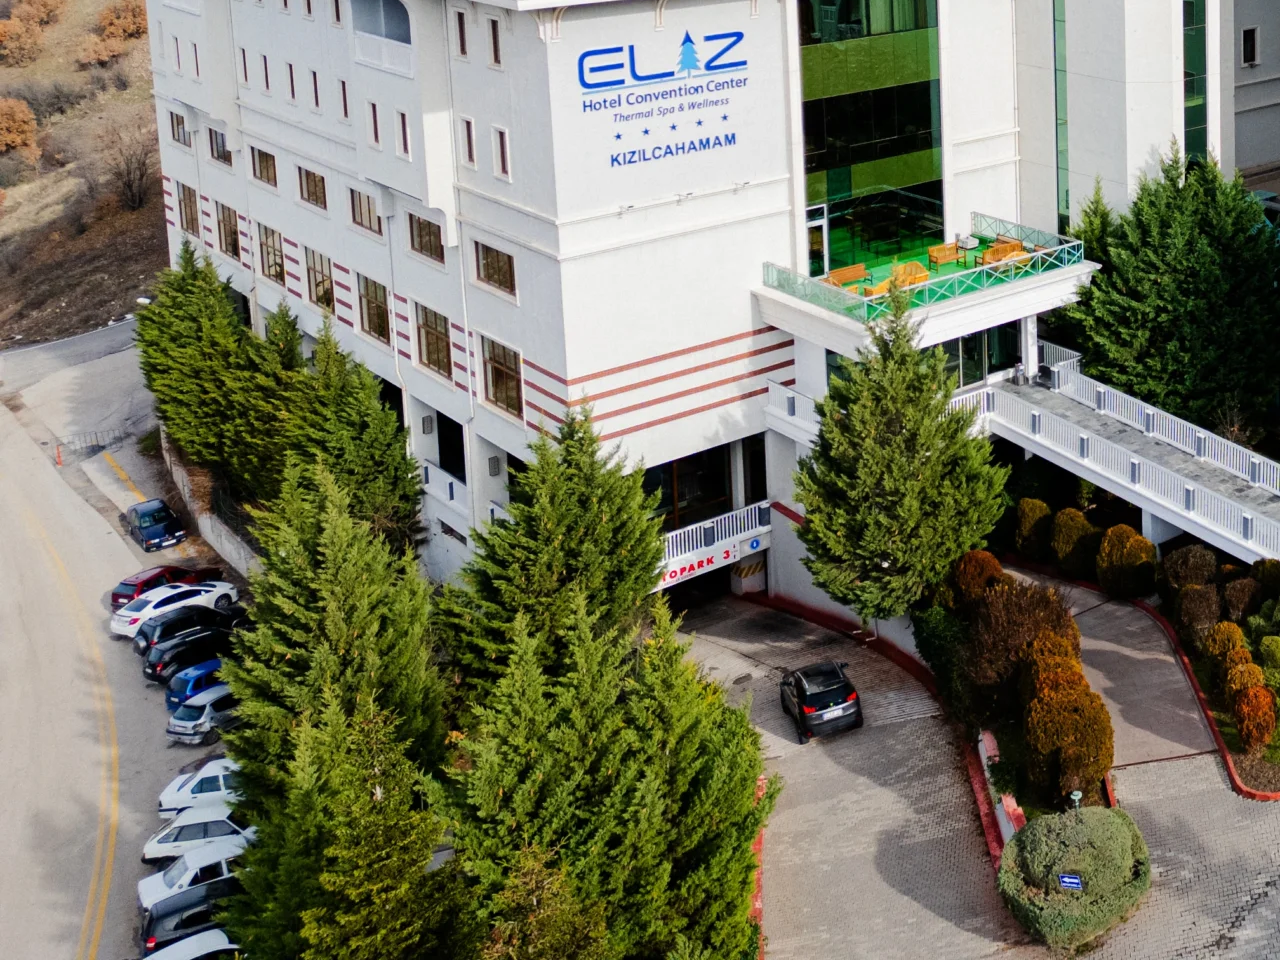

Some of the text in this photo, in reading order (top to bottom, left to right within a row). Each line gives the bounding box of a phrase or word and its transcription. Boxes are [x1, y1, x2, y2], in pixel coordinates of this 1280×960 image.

[582, 76, 749, 113] Hotel Convention Center
[613, 97, 730, 123] Thermal Spa & Wellness
[610, 132, 737, 168] KIZILCAHAMAM
[722, 549, 731, 560] 3
